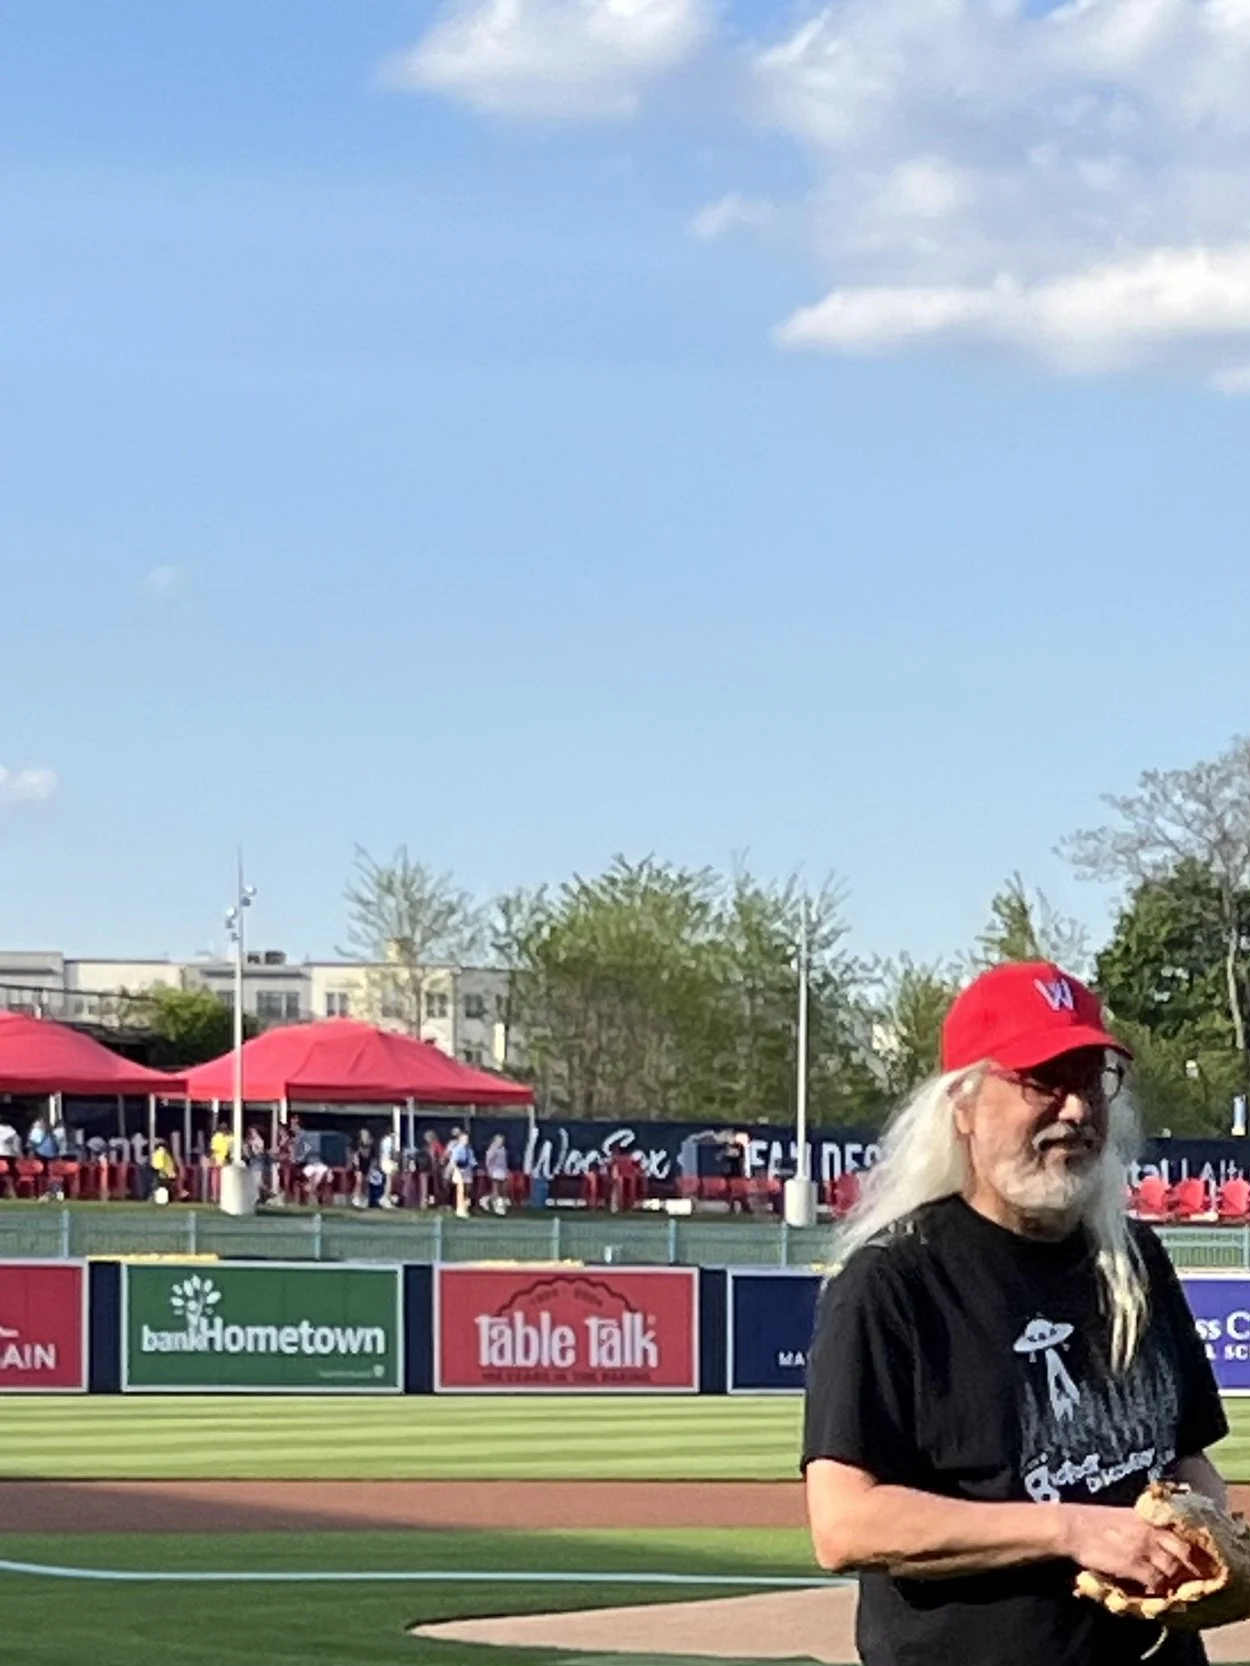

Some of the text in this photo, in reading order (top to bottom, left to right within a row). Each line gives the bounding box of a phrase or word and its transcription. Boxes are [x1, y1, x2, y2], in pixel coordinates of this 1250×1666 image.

[1033, 978, 1074, 1012] W
[474, 1310, 659, 1369] Table Talk
